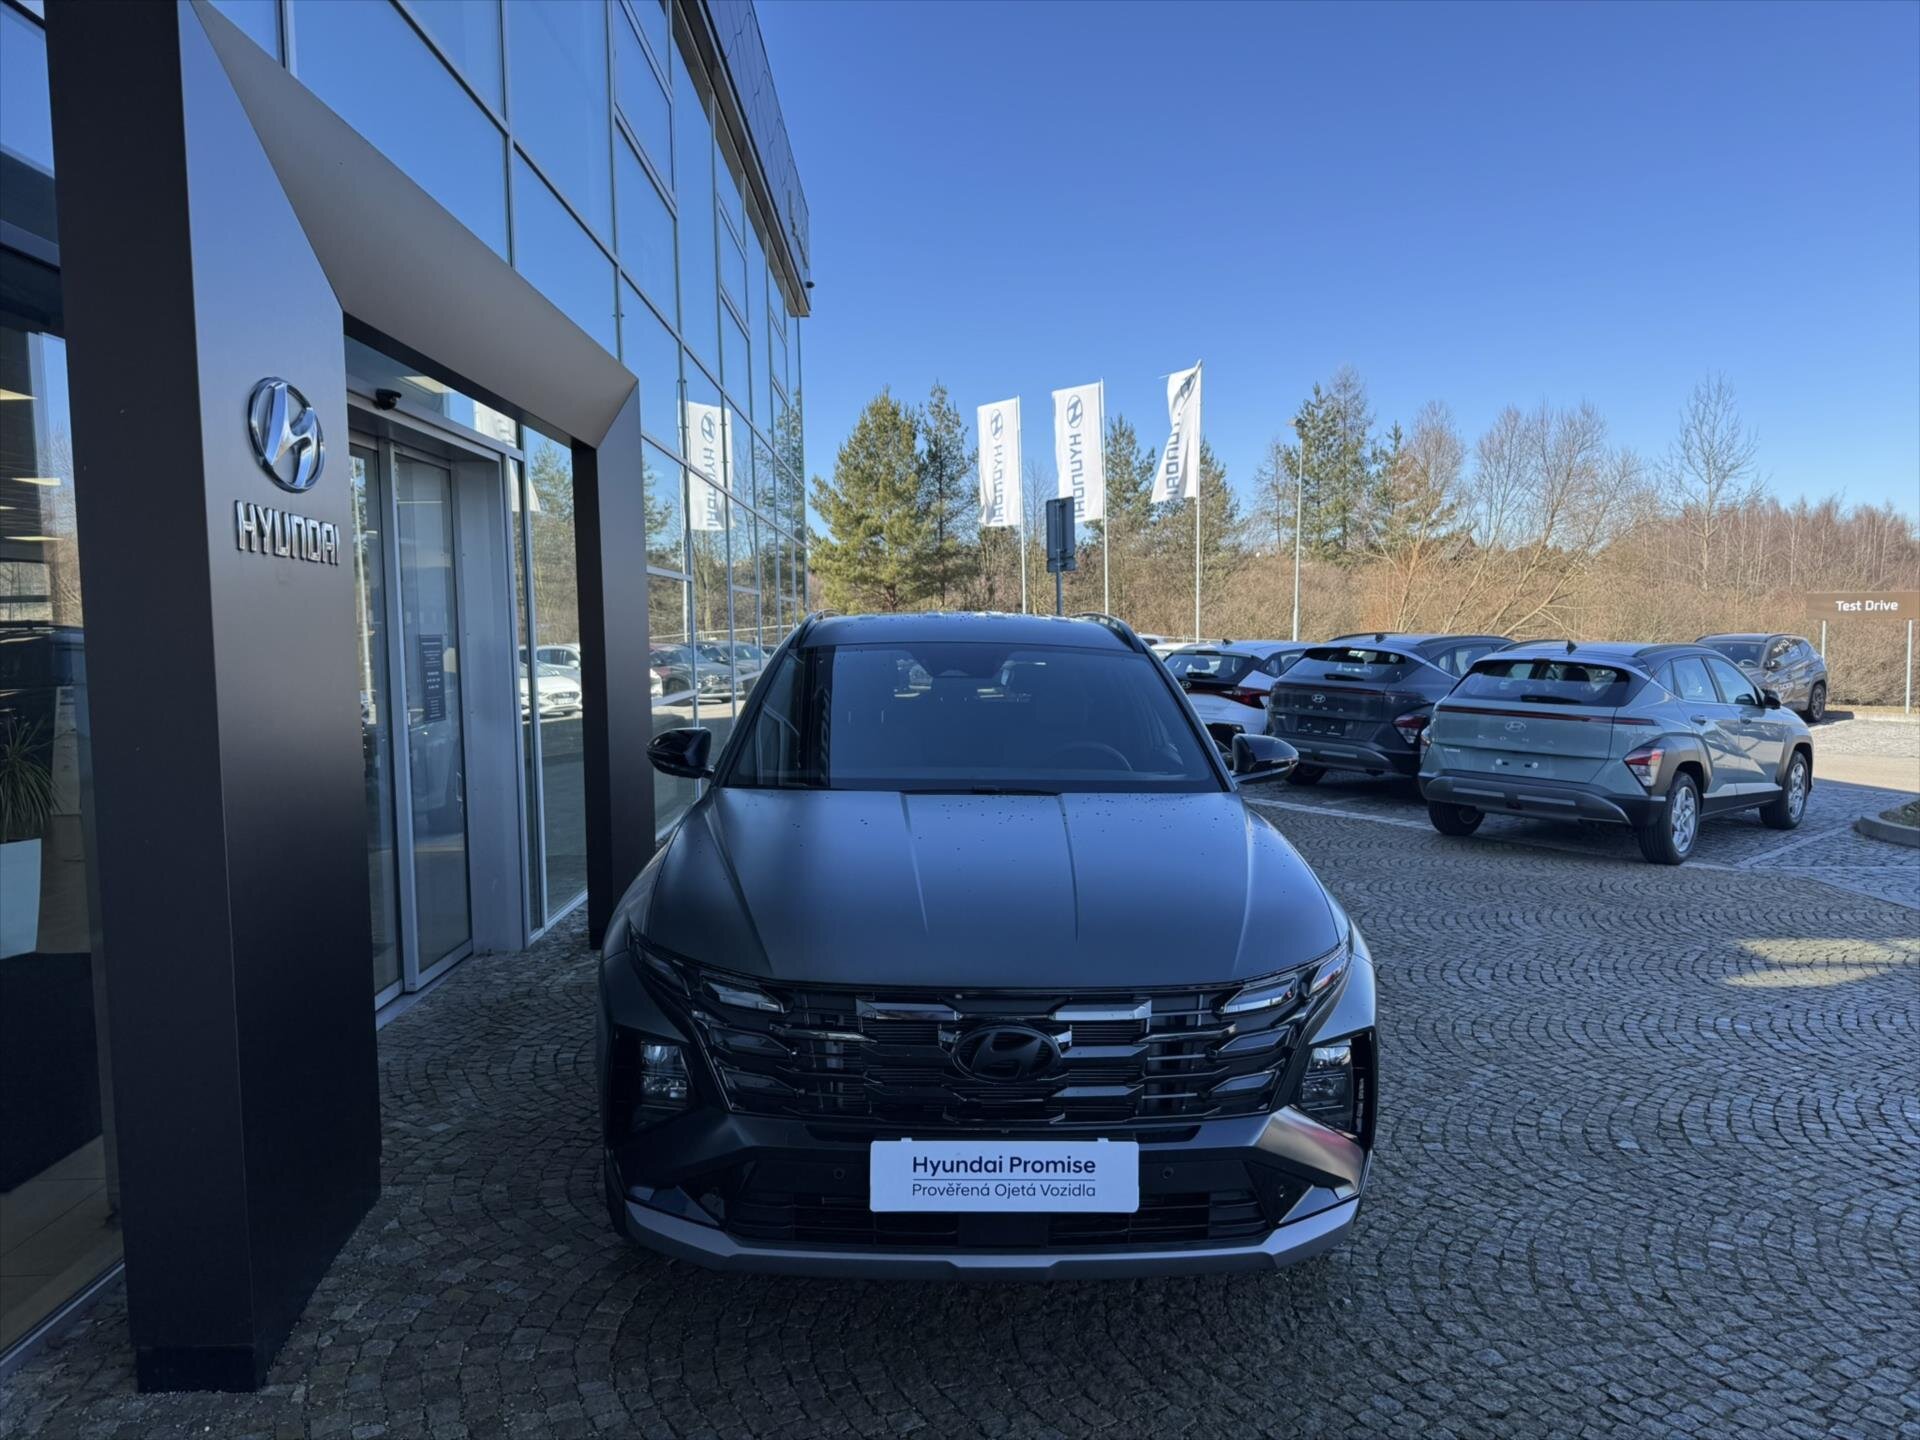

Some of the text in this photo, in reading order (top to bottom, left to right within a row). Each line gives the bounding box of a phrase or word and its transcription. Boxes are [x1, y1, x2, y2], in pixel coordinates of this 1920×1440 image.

[235, 500, 340, 566] HYUNDAI
[1835, 600, 1898, 611] Test Drive
[912, 1155, 1096, 1176] Hyundai Promise
[912, 1183, 1096, 1199] Prověřená Ojetá Vozidla
